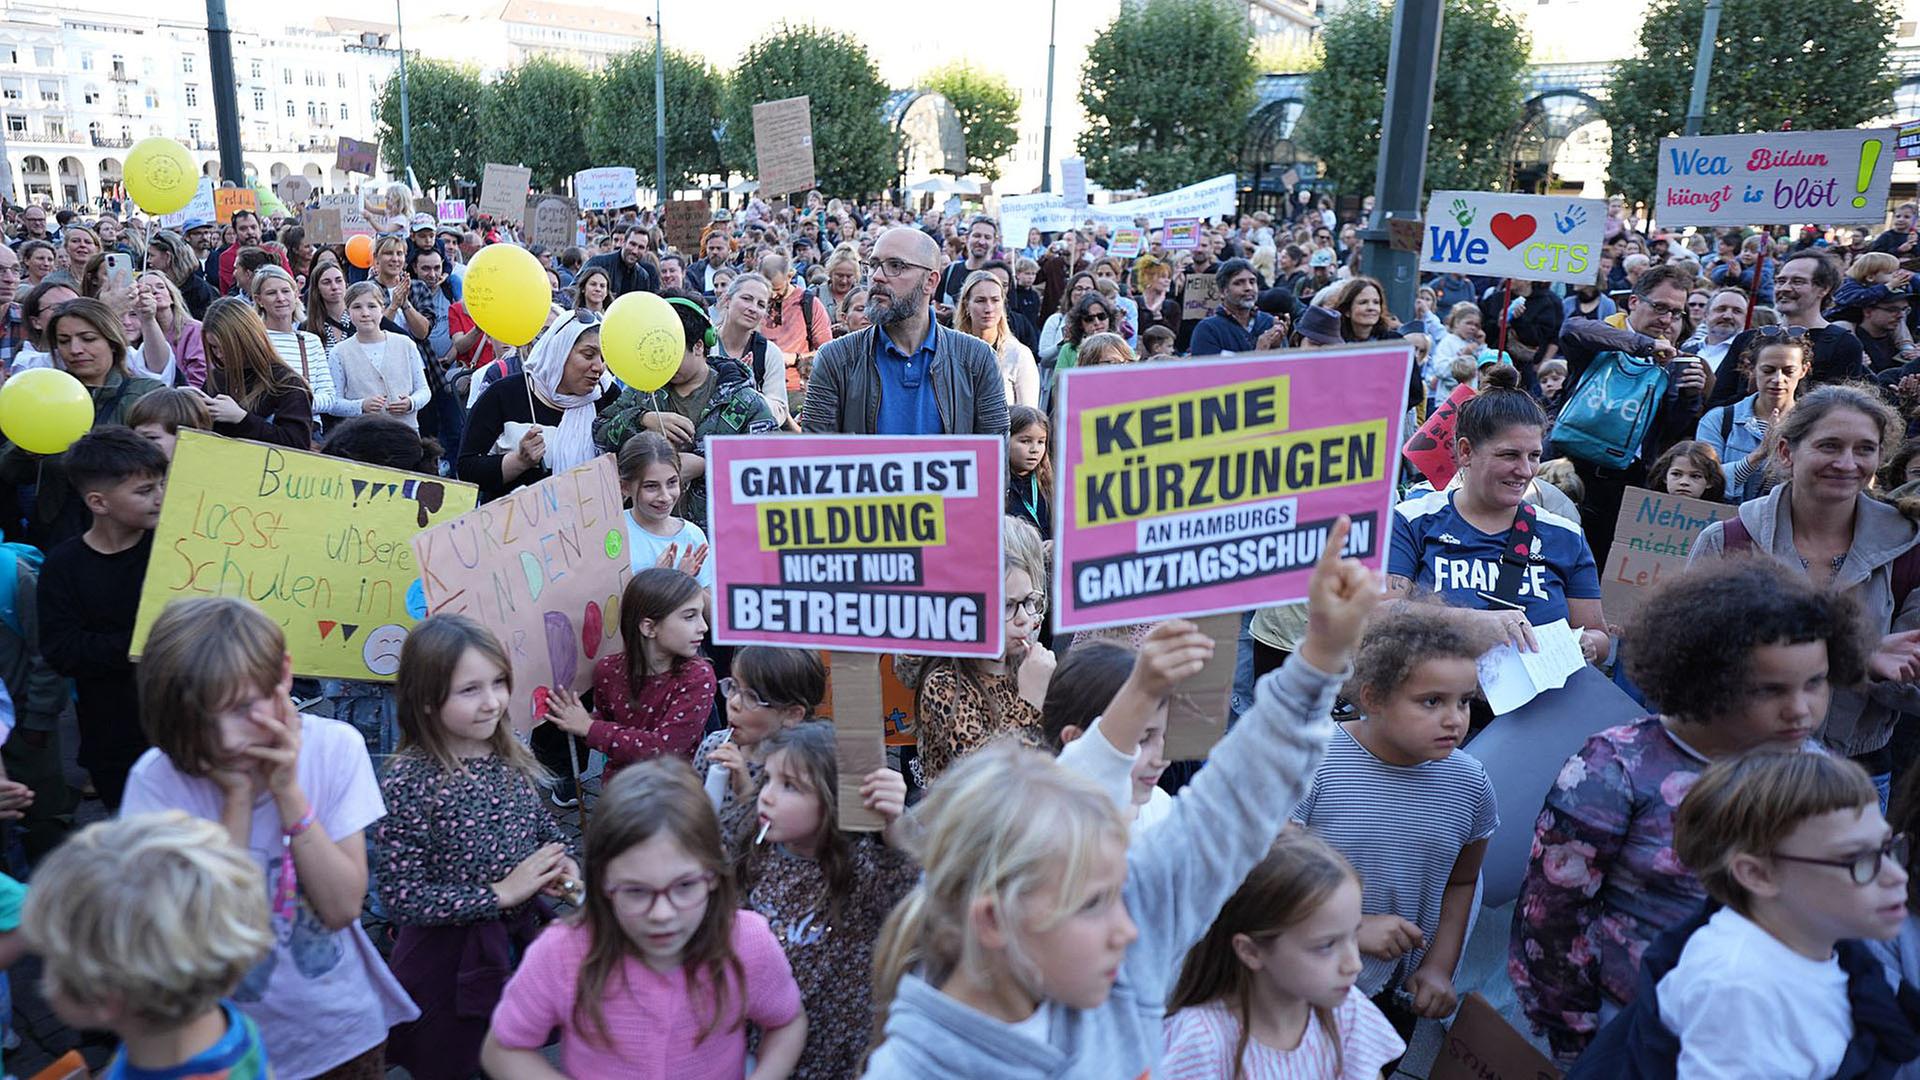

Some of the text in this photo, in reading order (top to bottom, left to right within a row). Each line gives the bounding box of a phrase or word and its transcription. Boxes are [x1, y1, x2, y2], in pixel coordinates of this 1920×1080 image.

[1670, 147, 1733, 176] Wea
[1746, 147, 1829, 172] Bildun
[1743, 184, 1764, 203] is
[1774, 177, 1840, 209] blöt
[1430, 226, 1589, 274] We GTS
[1095, 385, 1277, 456] KEINE
[740, 459, 972, 497] GANZTAG IST
[1086, 432, 1377, 523] KÜRZUNGEN
[192, 490, 412, 571] Lasst unsere
[766, 502, 937, 547] BILDUNG
[1145, 505, 1291, 546] AN HAMBURGS
[1629, 532, 1690, 557] nicht
[168, 537, 392, 618] Schulen in
[783, 552, 916, 584] NICHT NUR
[732, 588, 978, 642] BETREUUNG
